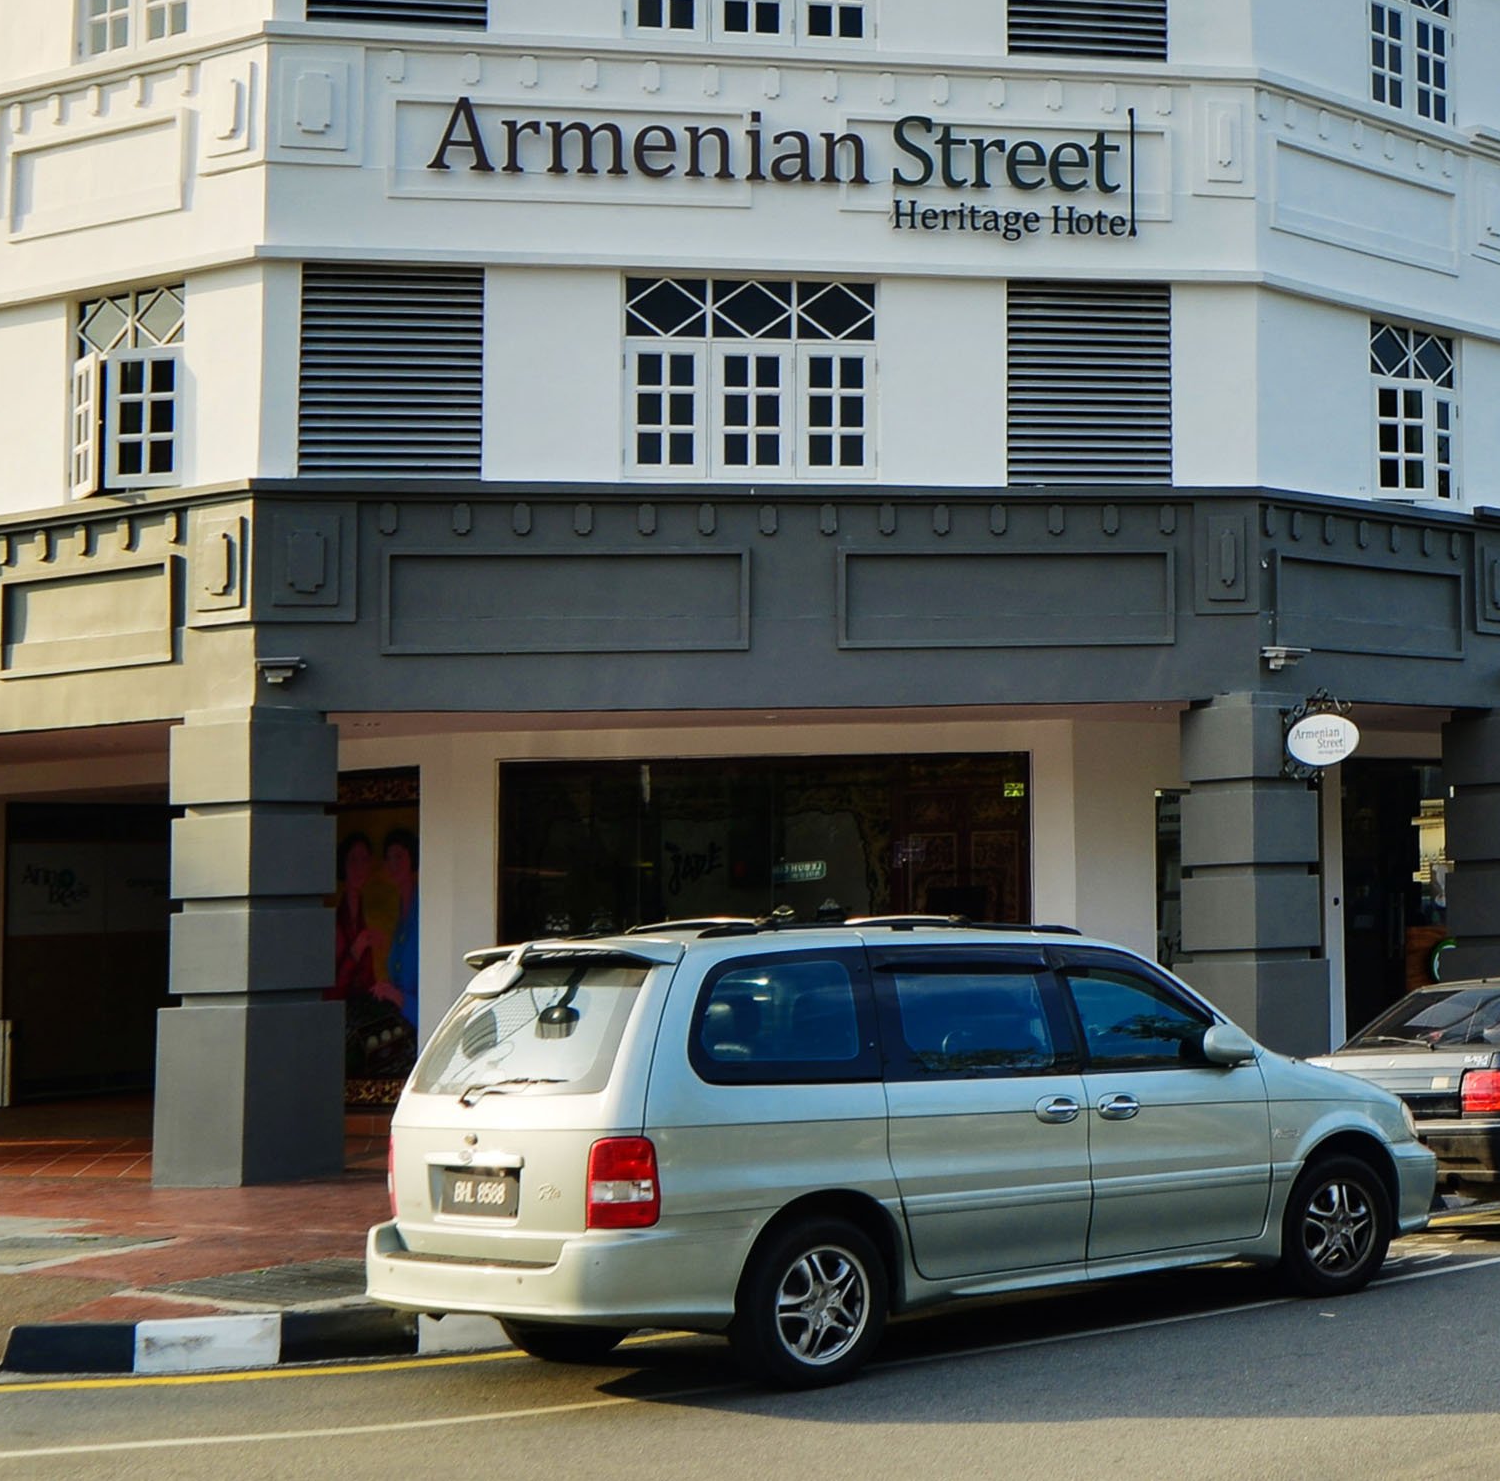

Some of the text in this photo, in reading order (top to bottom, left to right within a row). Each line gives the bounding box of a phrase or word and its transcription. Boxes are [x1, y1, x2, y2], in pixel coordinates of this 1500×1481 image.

[426, 96, 1122, 193] Armenian Street
[892, 200, 1041, 241] Heritage
[1294, 728, 1340, 740] Armenian
[1317, 738, 1344, 749] Street
[453, 1180, 475, 1203] BHL
